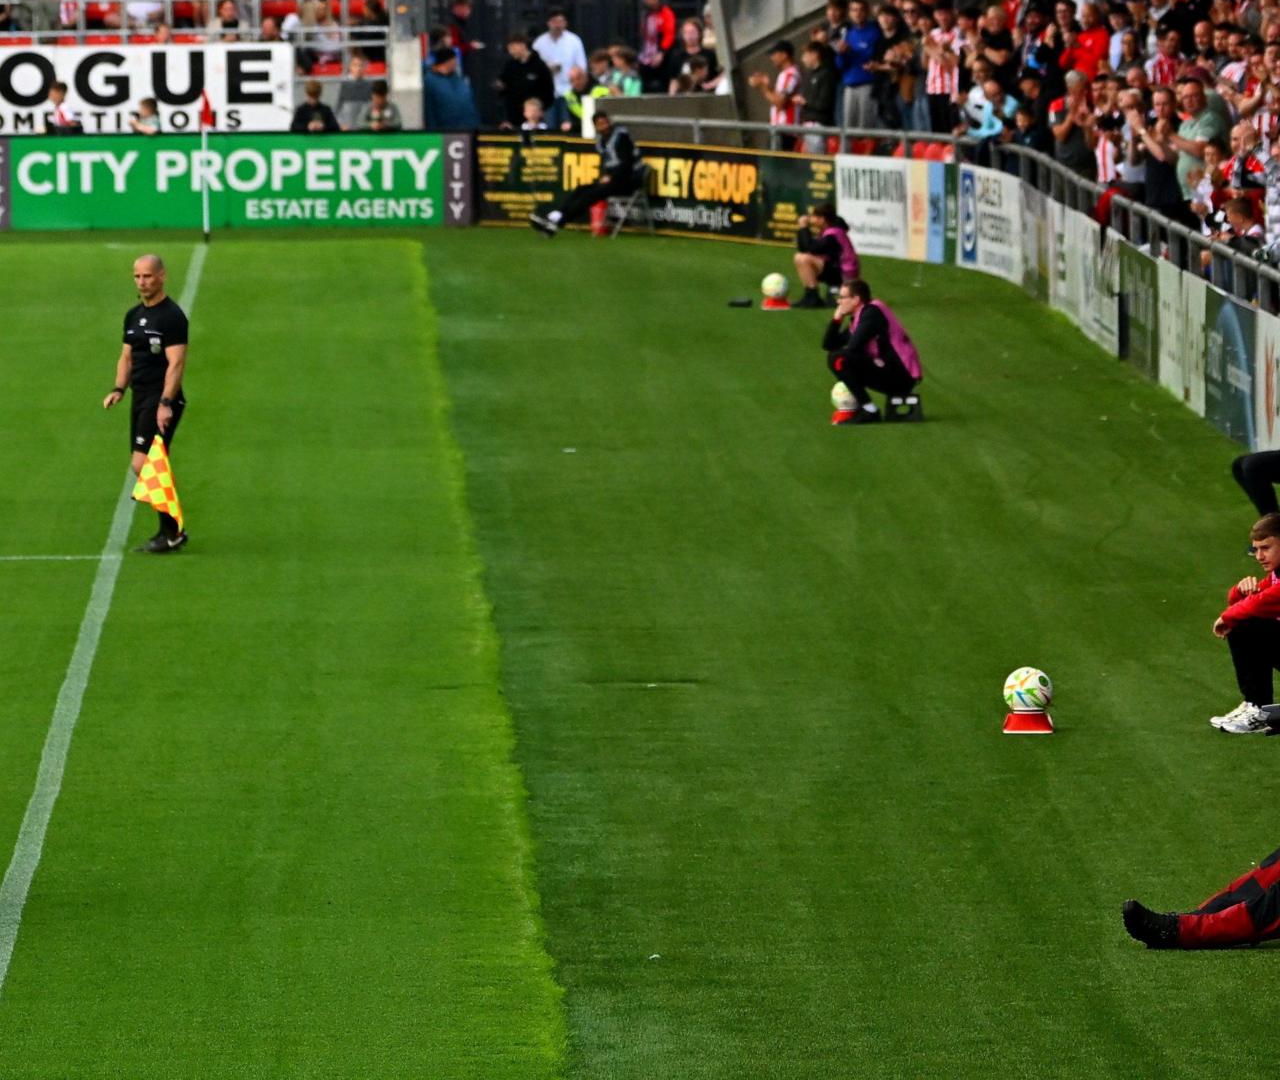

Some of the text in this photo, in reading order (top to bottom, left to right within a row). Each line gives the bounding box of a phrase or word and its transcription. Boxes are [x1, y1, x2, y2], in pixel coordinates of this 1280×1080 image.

[17, 150, 139, 196] CITY
[156, 148, 440, 194] PROPERTY
[447, 140, 464, 221] CITY
[692, 159, 757, 205] GROUP
[245, 197, 434, 221] ESTATE AGENTS
